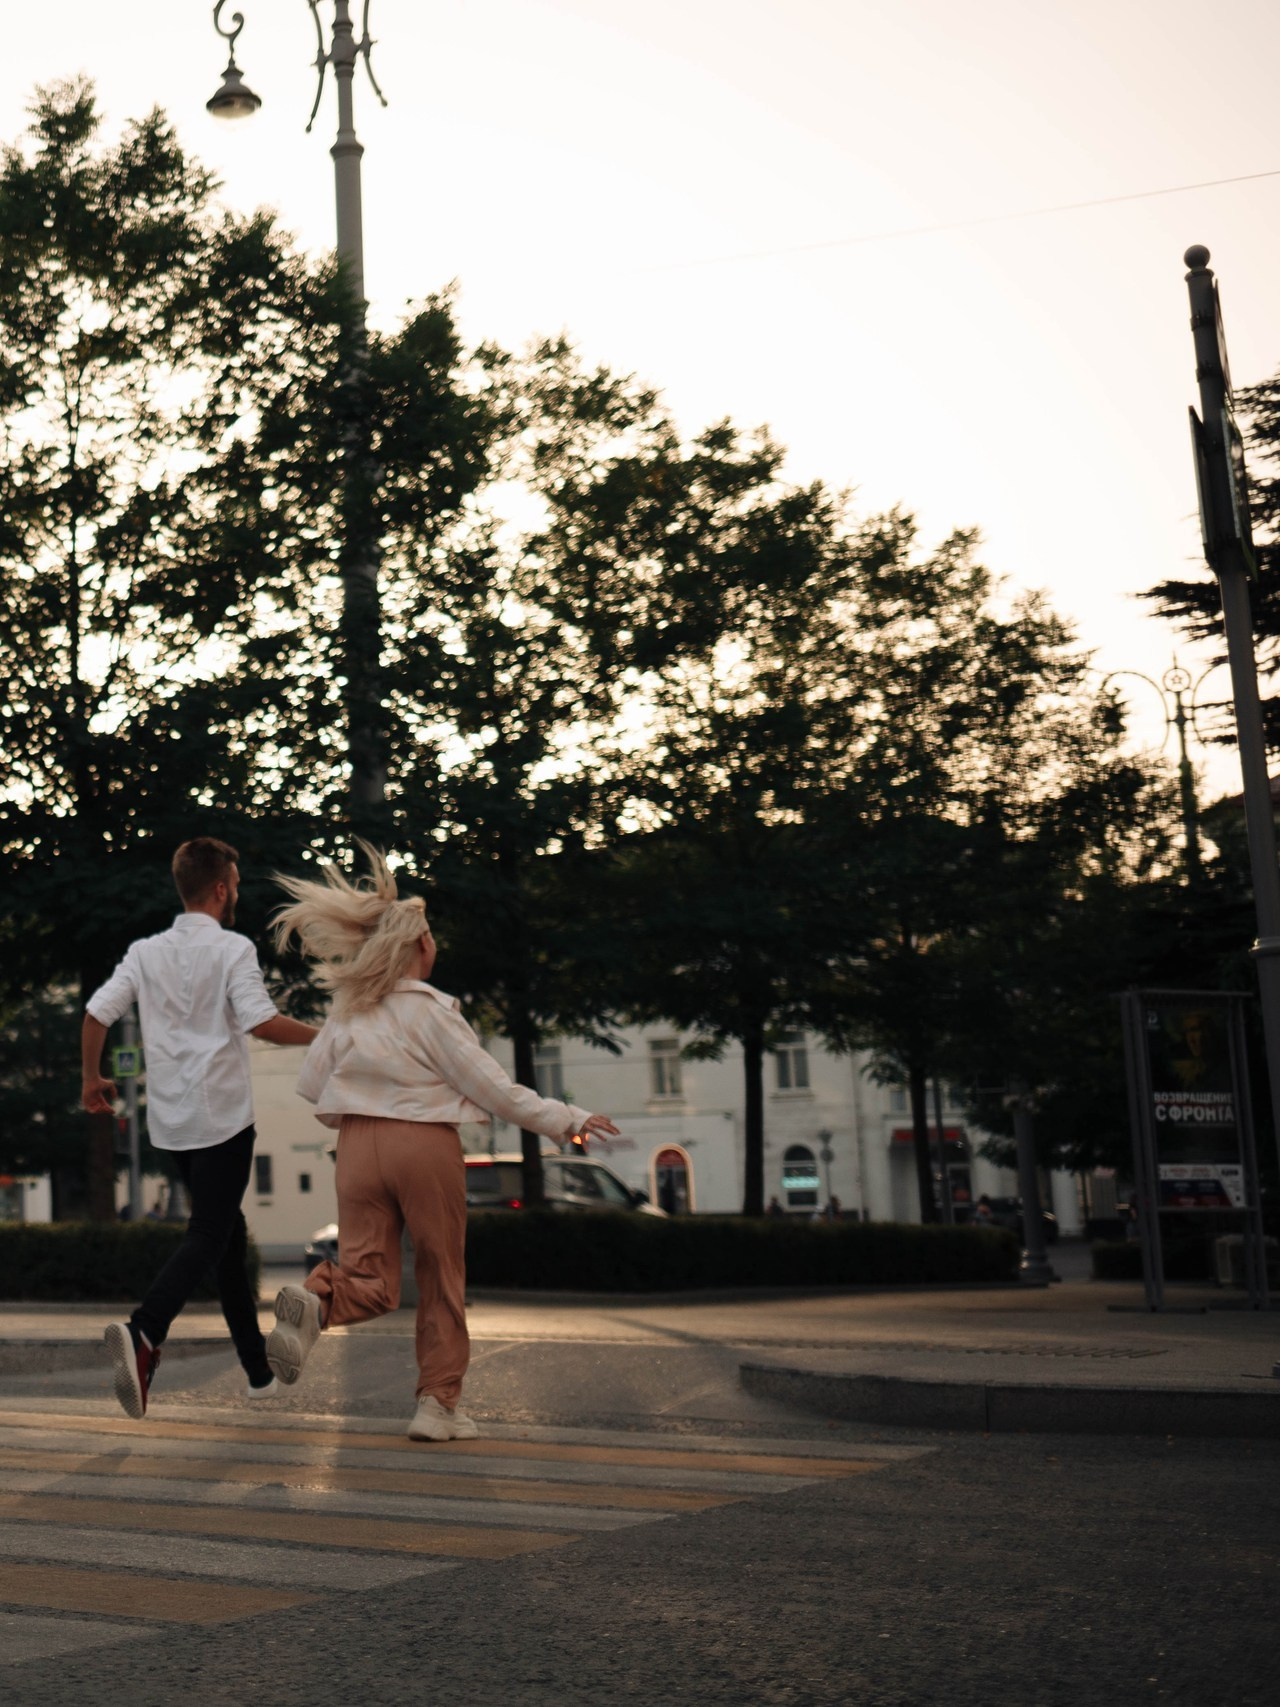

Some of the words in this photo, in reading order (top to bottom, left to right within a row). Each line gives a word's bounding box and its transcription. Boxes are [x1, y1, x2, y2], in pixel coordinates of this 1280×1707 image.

[1153, 1091, 1233, 1104] ВОЗВРАЩЕНИЕ
[1155, 1104, 1167, 1122] С
[1168, 1104, 1234, 1122] ФРОНТА
